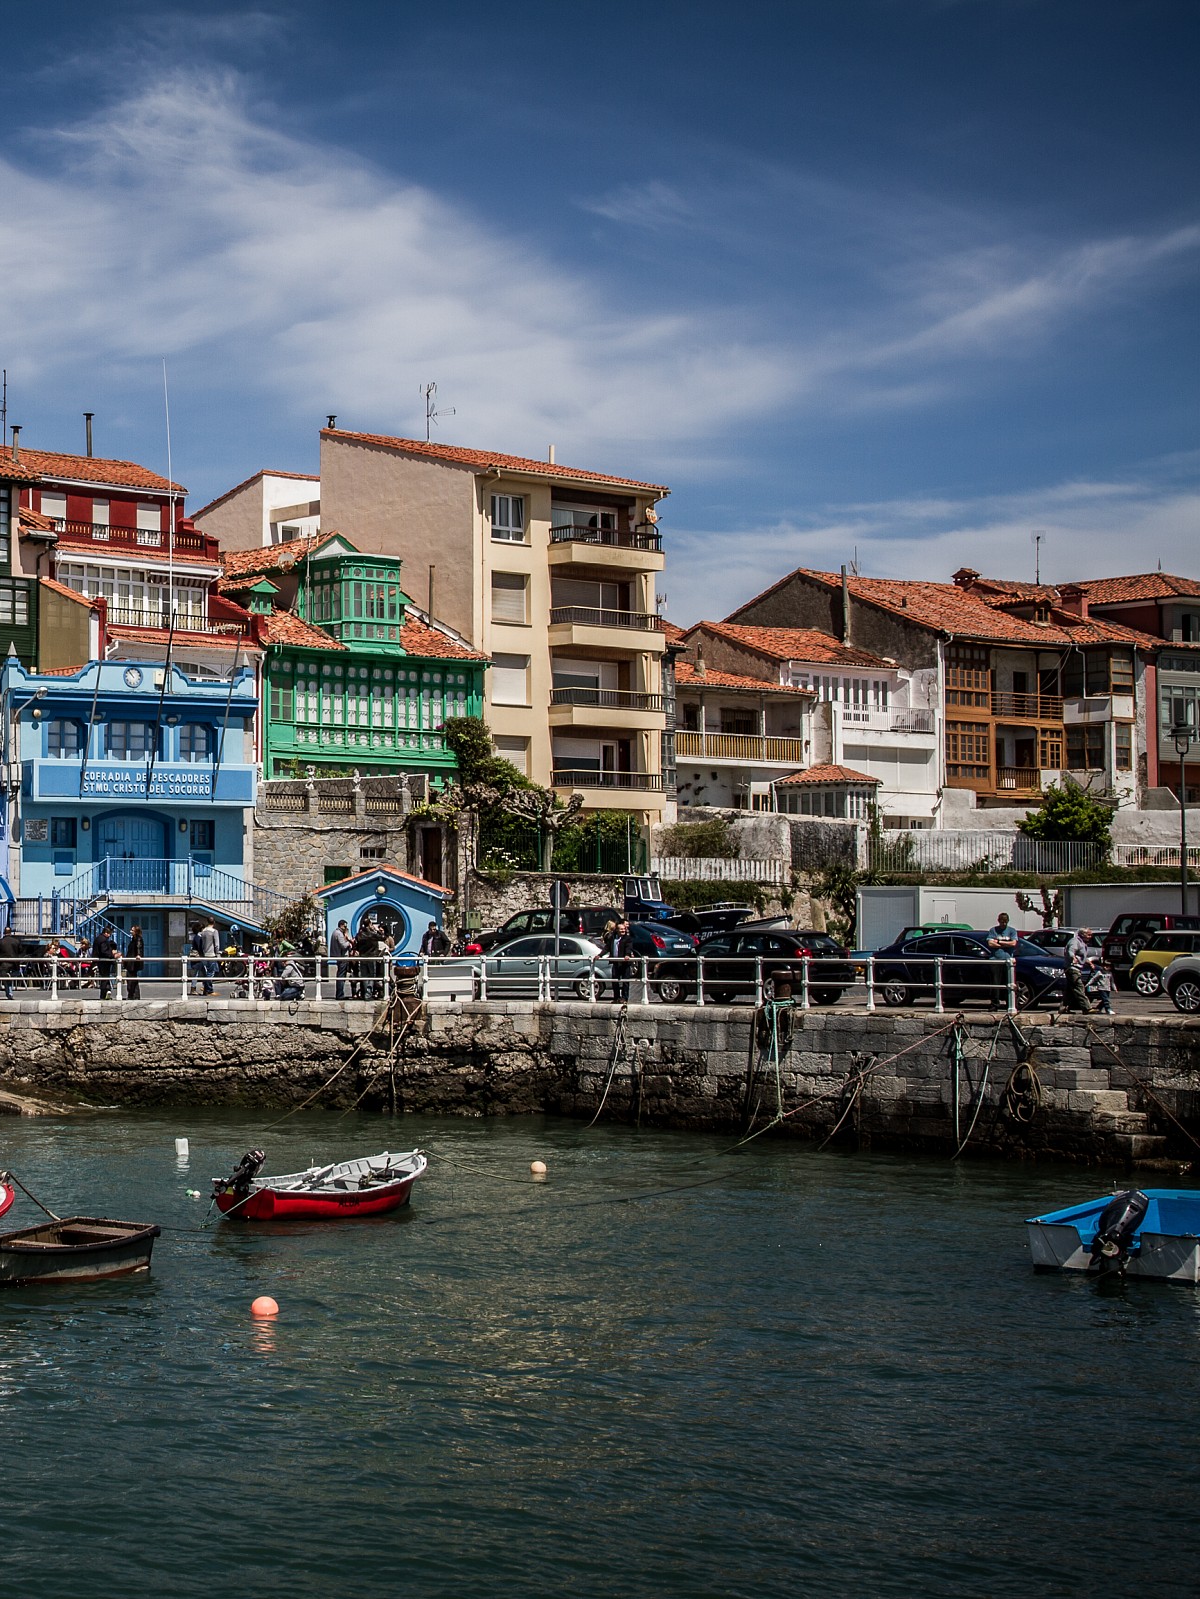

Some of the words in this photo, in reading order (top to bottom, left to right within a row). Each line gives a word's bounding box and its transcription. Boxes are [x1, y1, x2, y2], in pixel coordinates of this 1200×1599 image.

[84, 771, 131, 782] COFRADIA
[136, 772, 147, 782] DE
[152, 773, 210, 784] PESCADORES
[83, 782, 111, 793] STMO.
[113, 783, 146, 793] CRISTO
[149, 784, 165, 794] DEL
[169, 785, 210, 795] SOCORRO
